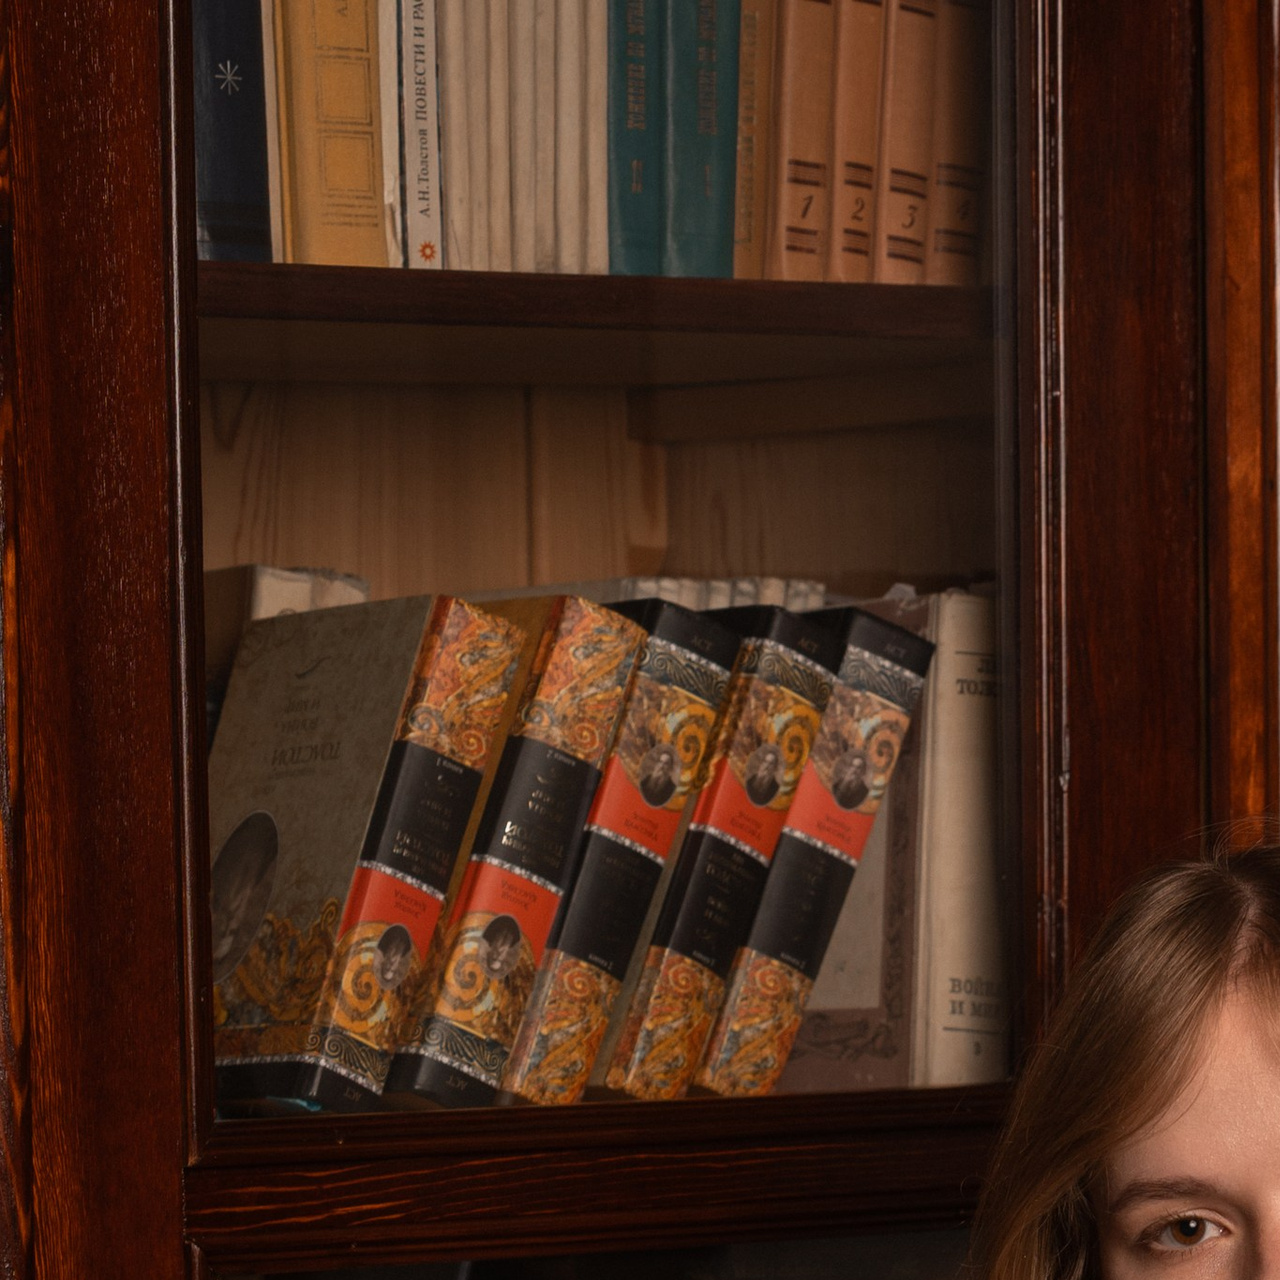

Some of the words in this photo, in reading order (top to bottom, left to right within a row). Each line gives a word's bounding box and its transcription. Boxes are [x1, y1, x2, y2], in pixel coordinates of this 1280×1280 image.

[413, 26, 425, 38] И
[413, 44, 428, 121] ПОВЕСТИ
[801, 195, 814, 220] 1
[851, 196, 865, 221] 2
[901, 204, 919, 229] 3
